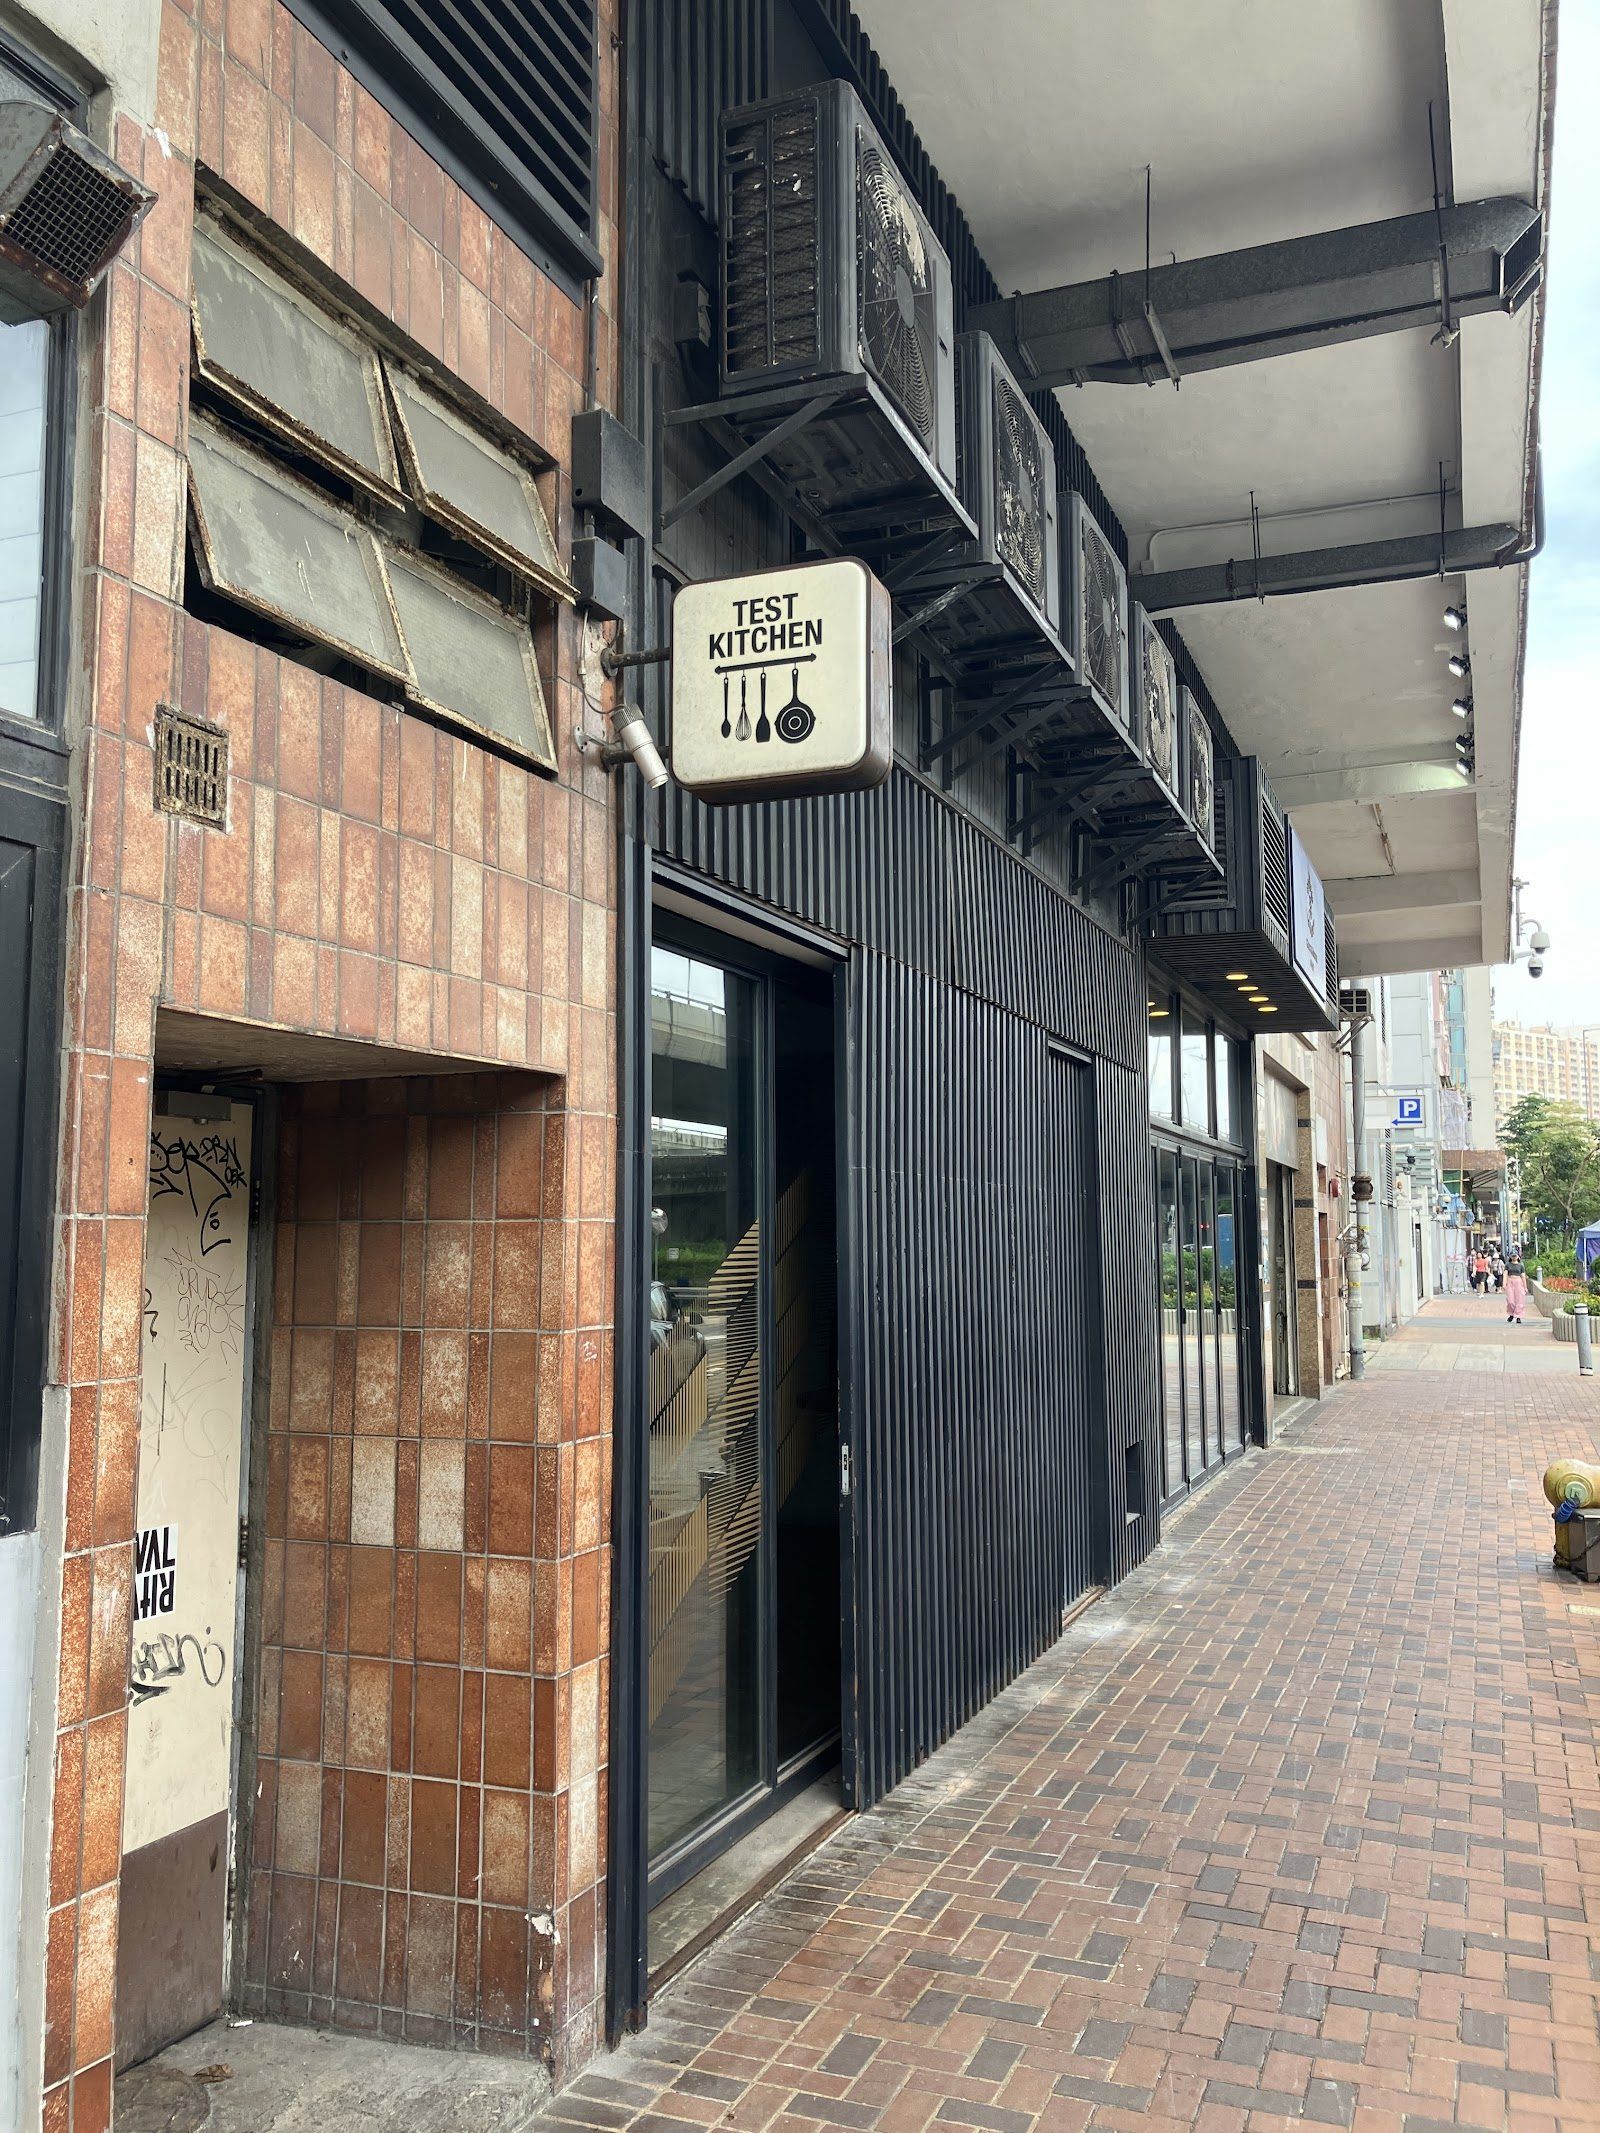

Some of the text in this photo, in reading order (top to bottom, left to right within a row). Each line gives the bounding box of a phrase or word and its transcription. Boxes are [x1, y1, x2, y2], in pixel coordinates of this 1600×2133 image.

[733, 593, 798, 626] TEST
[709, 619, 822, 660] KITCHEN
[1403, 1100, 1418, 1117] P
